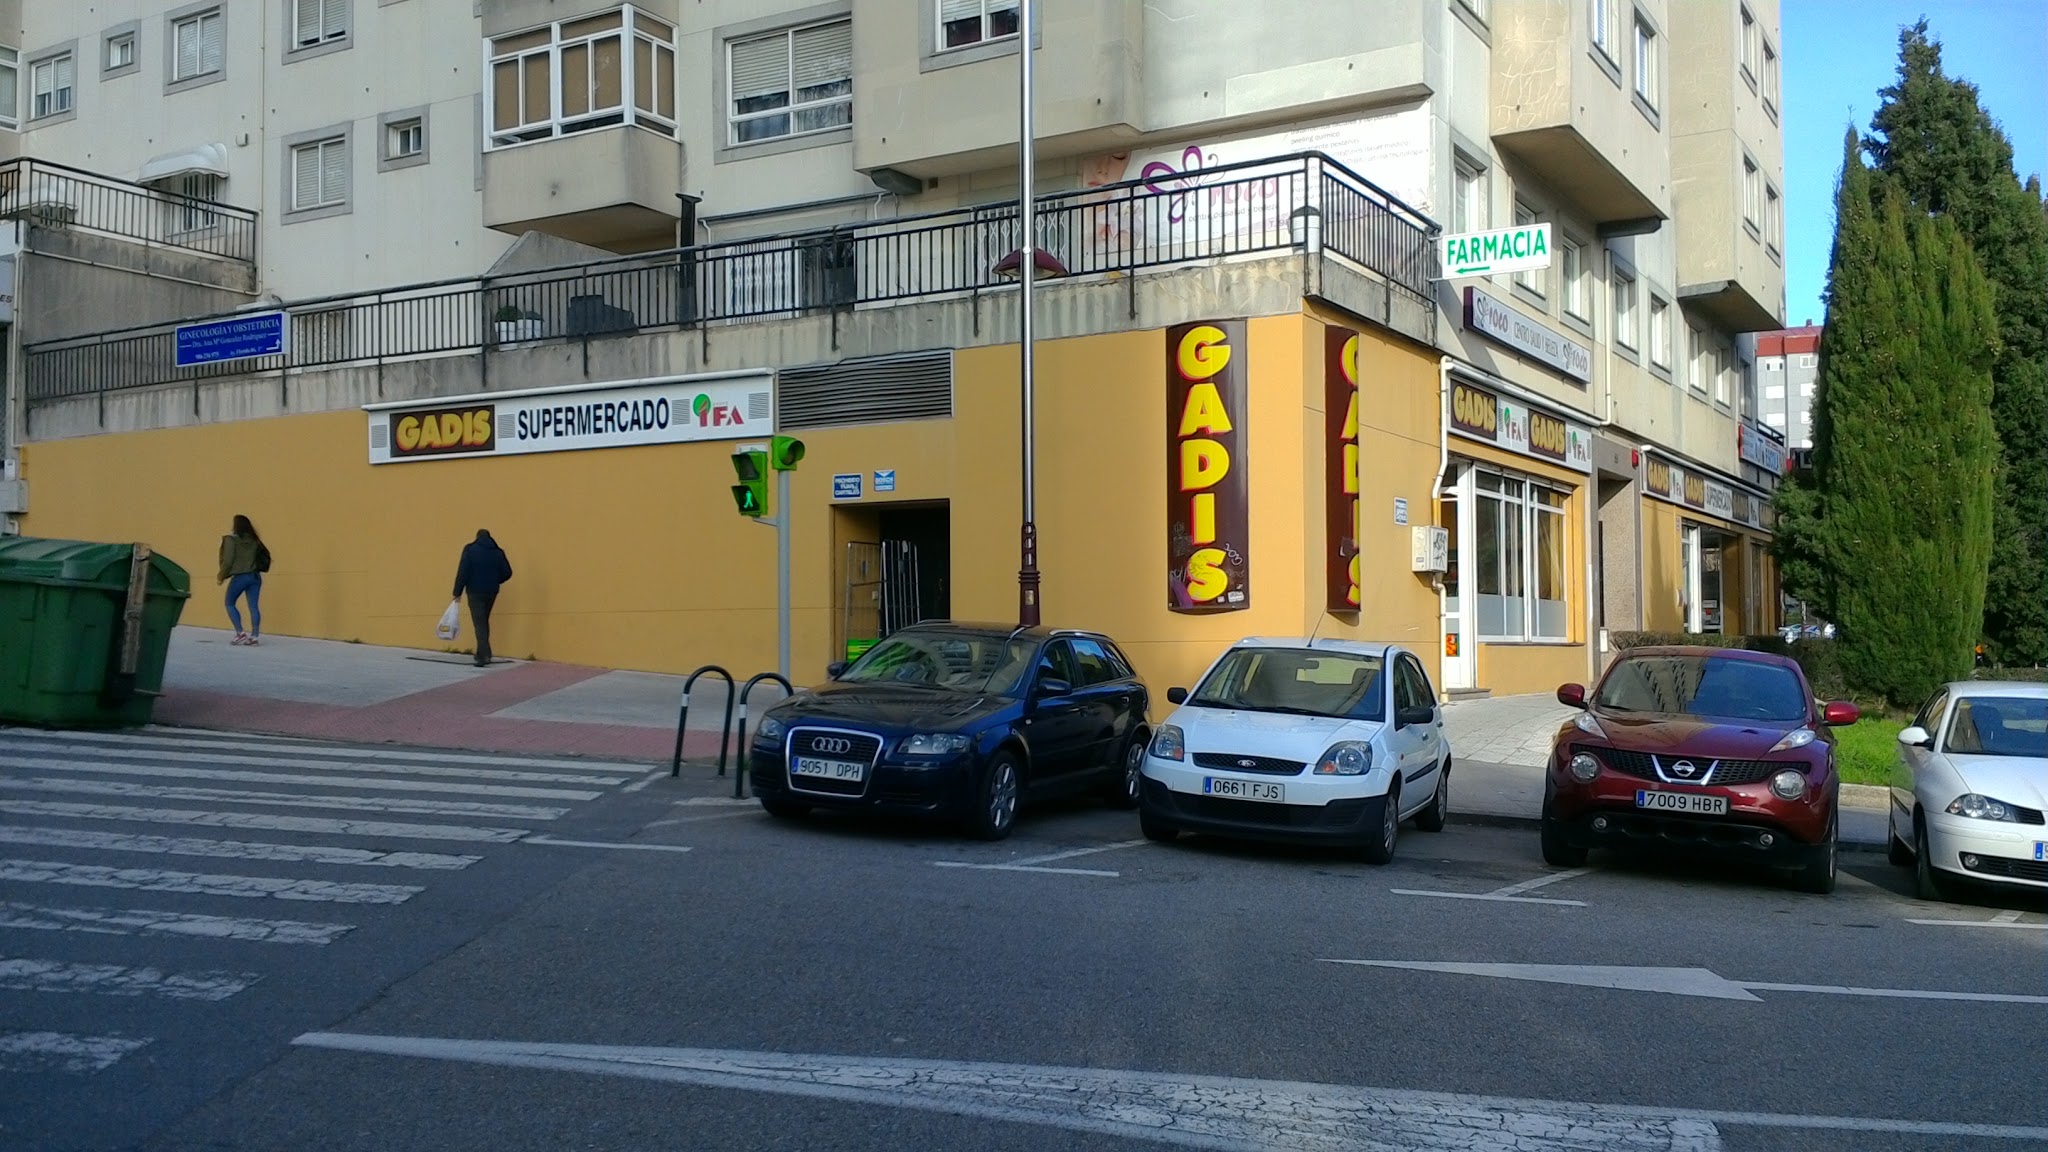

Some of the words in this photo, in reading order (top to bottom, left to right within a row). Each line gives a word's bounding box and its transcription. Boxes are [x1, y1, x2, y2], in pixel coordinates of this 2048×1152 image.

[1447, 229, 1547, 266] FARMACIA
[233, 319, 280, 333] OBSTETRICIA
[396, 409, 492, 452] GADIS
[518, 397, 670, 441] SUPERMERCADO
[1453, 385, 1496, 433] GADIS
[1530, 413, 1566, 455] GADIS
[1177, 326, 1234, 605] GADIS
[800, 760, 828, 775] 9051
[836, 763, 860, 779] DPH
[1214, 780, 1246, 796] 0661
[1252, 784, 1279, 799] FJS
[1647, 793, 1687, 809] 7009
[1692, 797, 1723, 813] HBR
